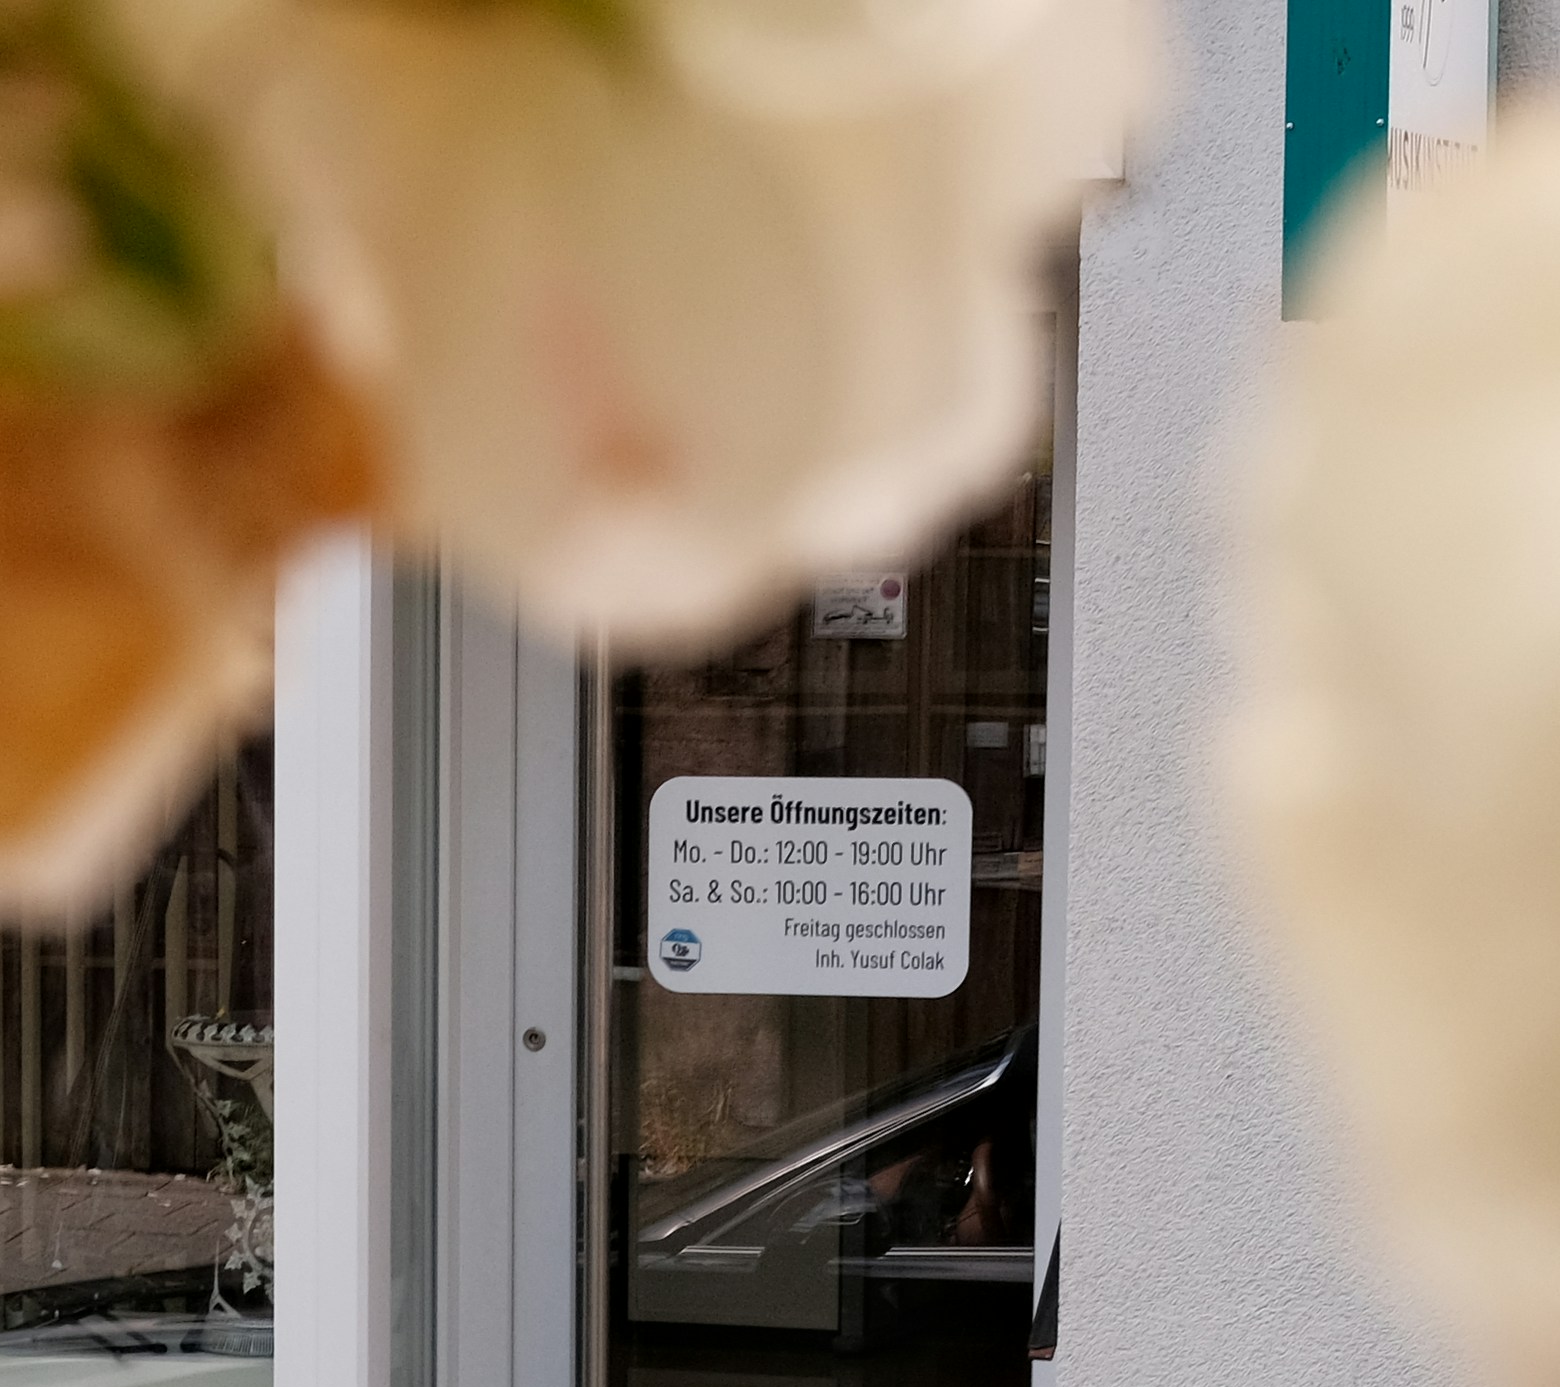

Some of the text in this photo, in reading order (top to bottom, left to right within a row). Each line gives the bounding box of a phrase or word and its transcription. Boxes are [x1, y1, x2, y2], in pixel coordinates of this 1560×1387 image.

[686, 794, 947, 831] Unsere Öffnungszeiten:
[673, 839, 706, 864] Mo.
[730, 839, 769, 864] Do.:
[775, 840, 828, 865] 12:00
[851, 841, 903, 866] 19:00
[910, 842, 948, 866] Uhr
[669, 878, 700, 903] Sa.
[707, 879, 722, 904] &
[730, 879, 768, 904] So.:
[775, 880, 827, 905] 10:00
[850, 881, 902, 906] 16:00
[909, 882, 946, 906] Uhr
[784, 917, 946, 943] Freitag geschlossen
[815, 949, 944, 971] Inh. Yusuf Colak
